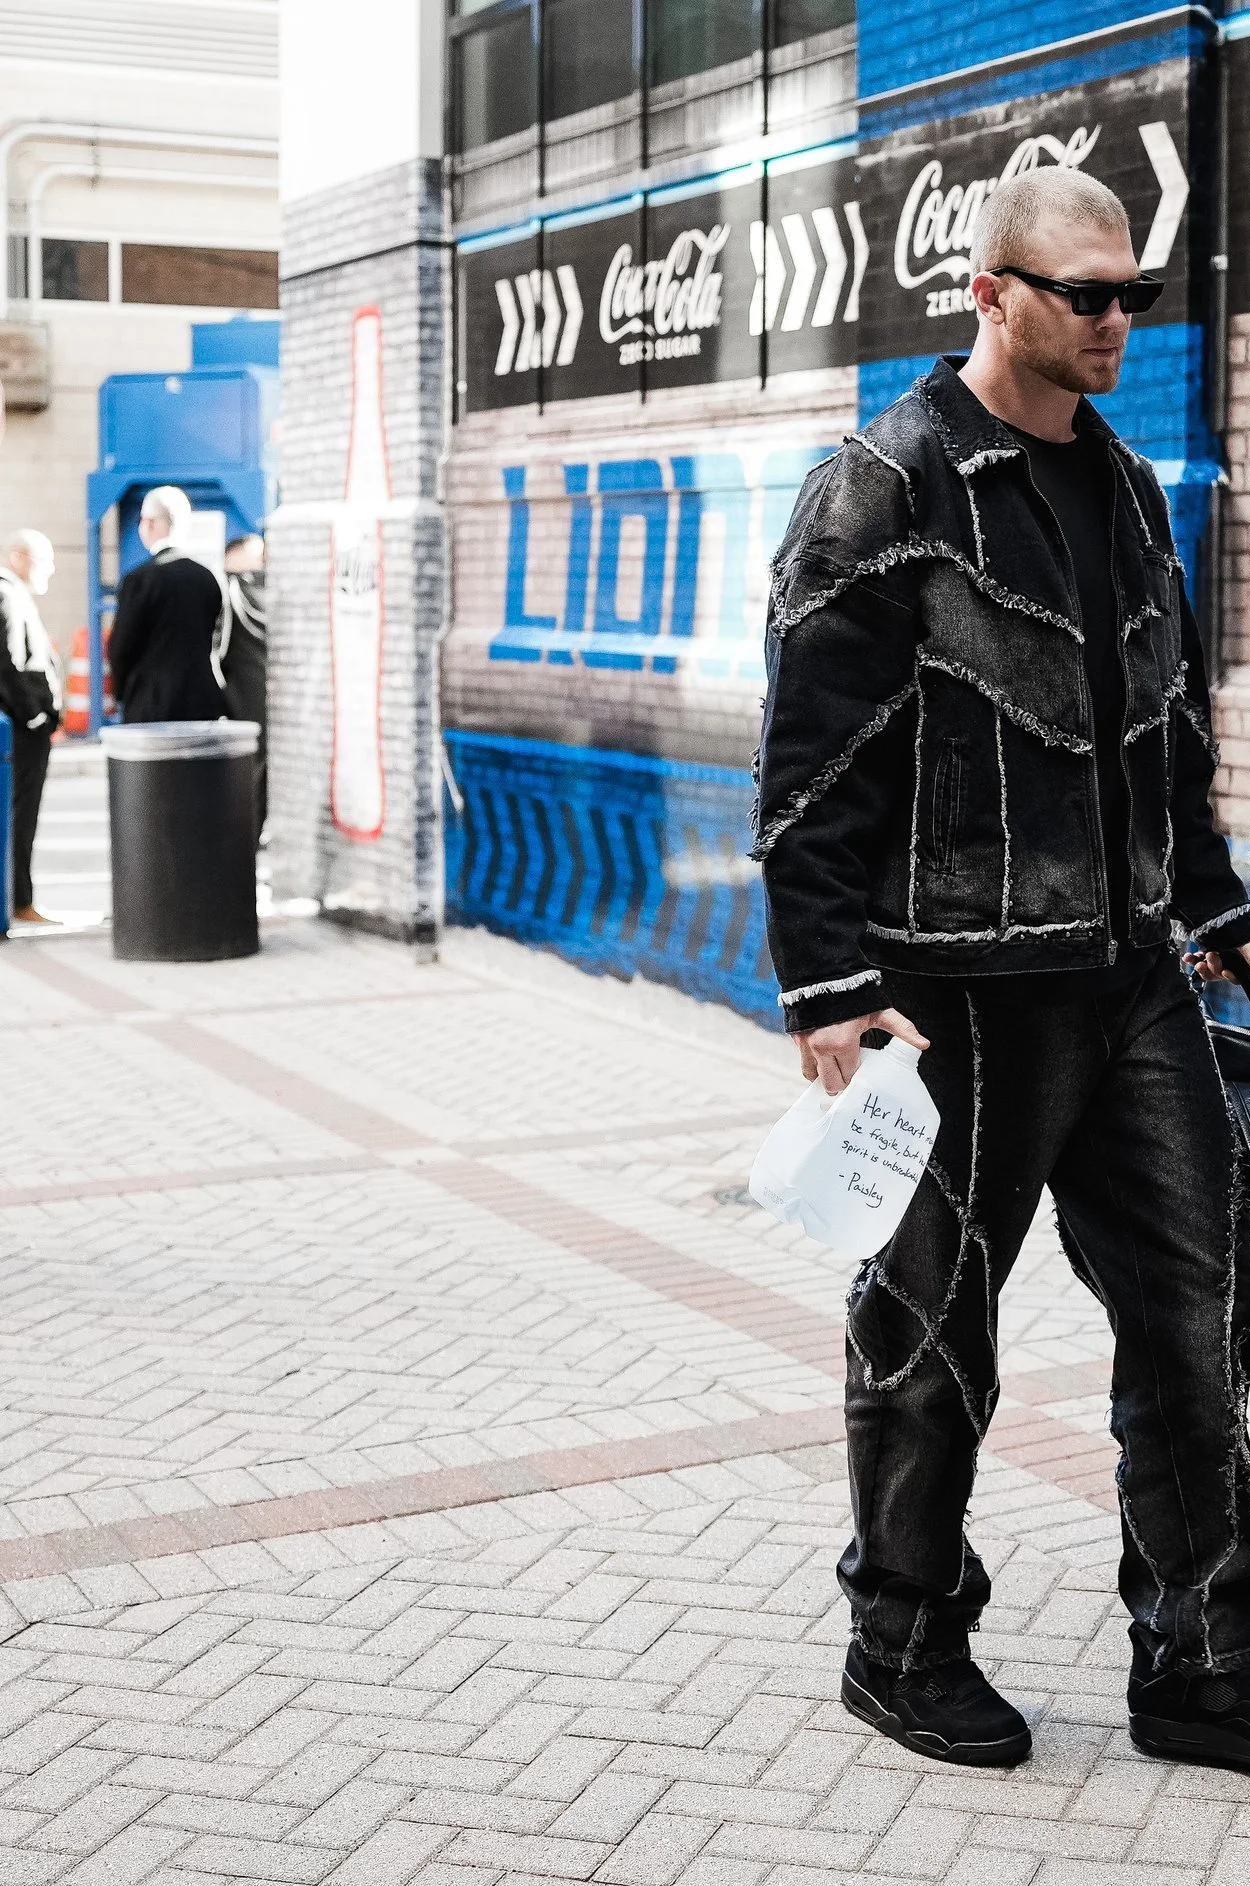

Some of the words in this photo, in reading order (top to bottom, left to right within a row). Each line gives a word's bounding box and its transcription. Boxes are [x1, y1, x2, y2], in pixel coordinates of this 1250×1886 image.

[599, 222, 732, 344] Coca-Cola
[926, 286, 976, 317] ZERO
[619, 340, 655, 366] ZERO
[654, 333, 702, 361] SUGAR
[489, 446, 840, 682] LION
[863, 1093, 890, 1119] Her
[894, 1108, 925, 1138] heart
[851, 1119, 863, 1134] be
[903, 1145, 919, 1160] but
[871, 1152, 879, 1163] is
[847, 1172, 883, 1208] Paisley
